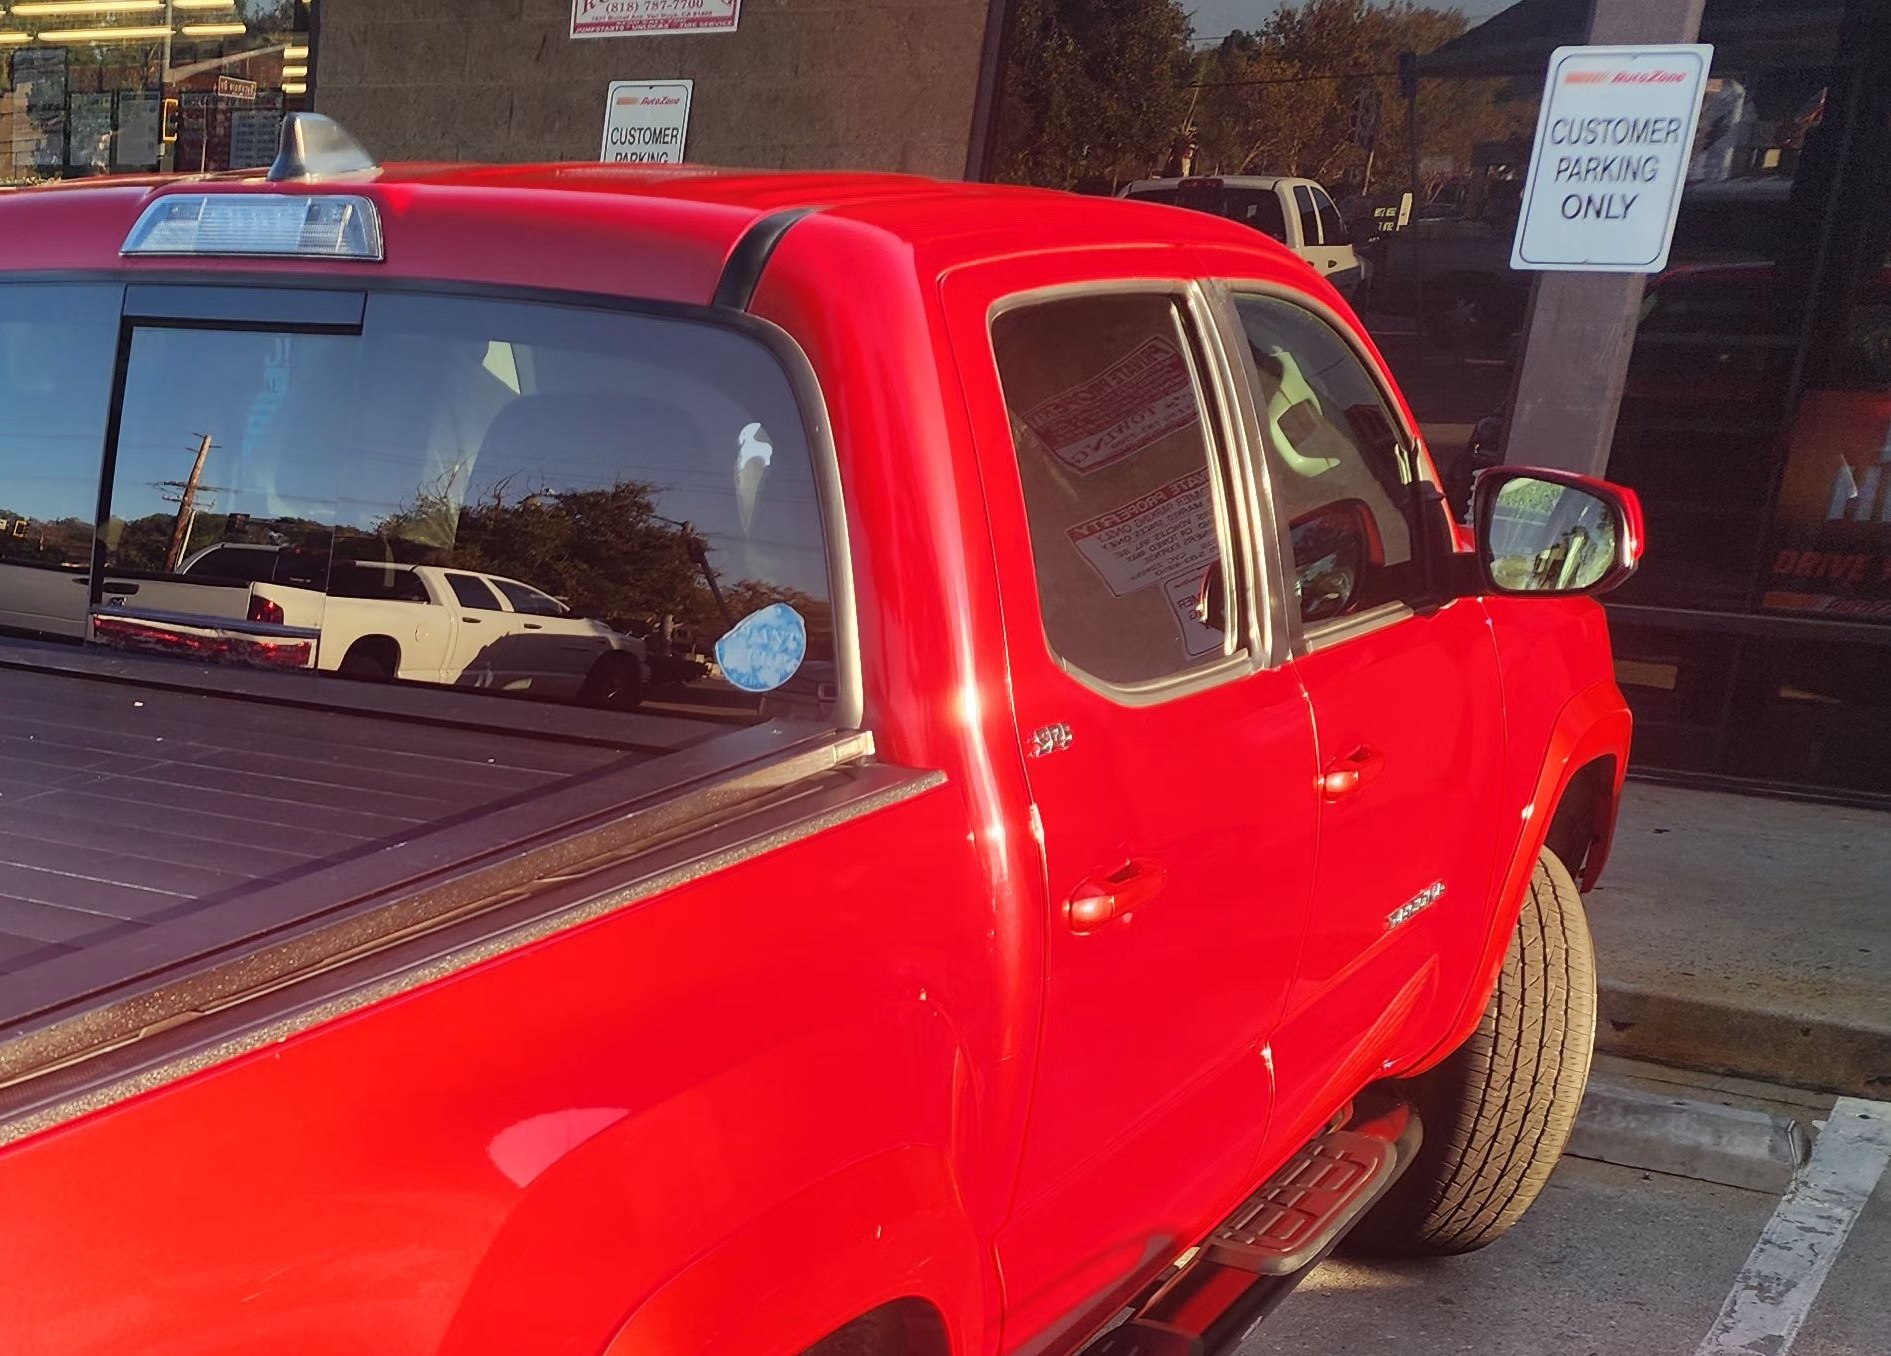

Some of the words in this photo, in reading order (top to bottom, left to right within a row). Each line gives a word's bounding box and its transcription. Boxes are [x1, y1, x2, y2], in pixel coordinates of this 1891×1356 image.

[606, 2, 639, 13] (818)
[1612, 69, 1689, 85] AutoZone
[610, 126, 680, 146] CUSTOMER
[1551, 117, 1682, 145] CUSTOMER
[614, 152, 669, 164] PARKING
[1554, 155, 1660, 183] PARKING
[1561, 192, 1640, 219] ONLY
